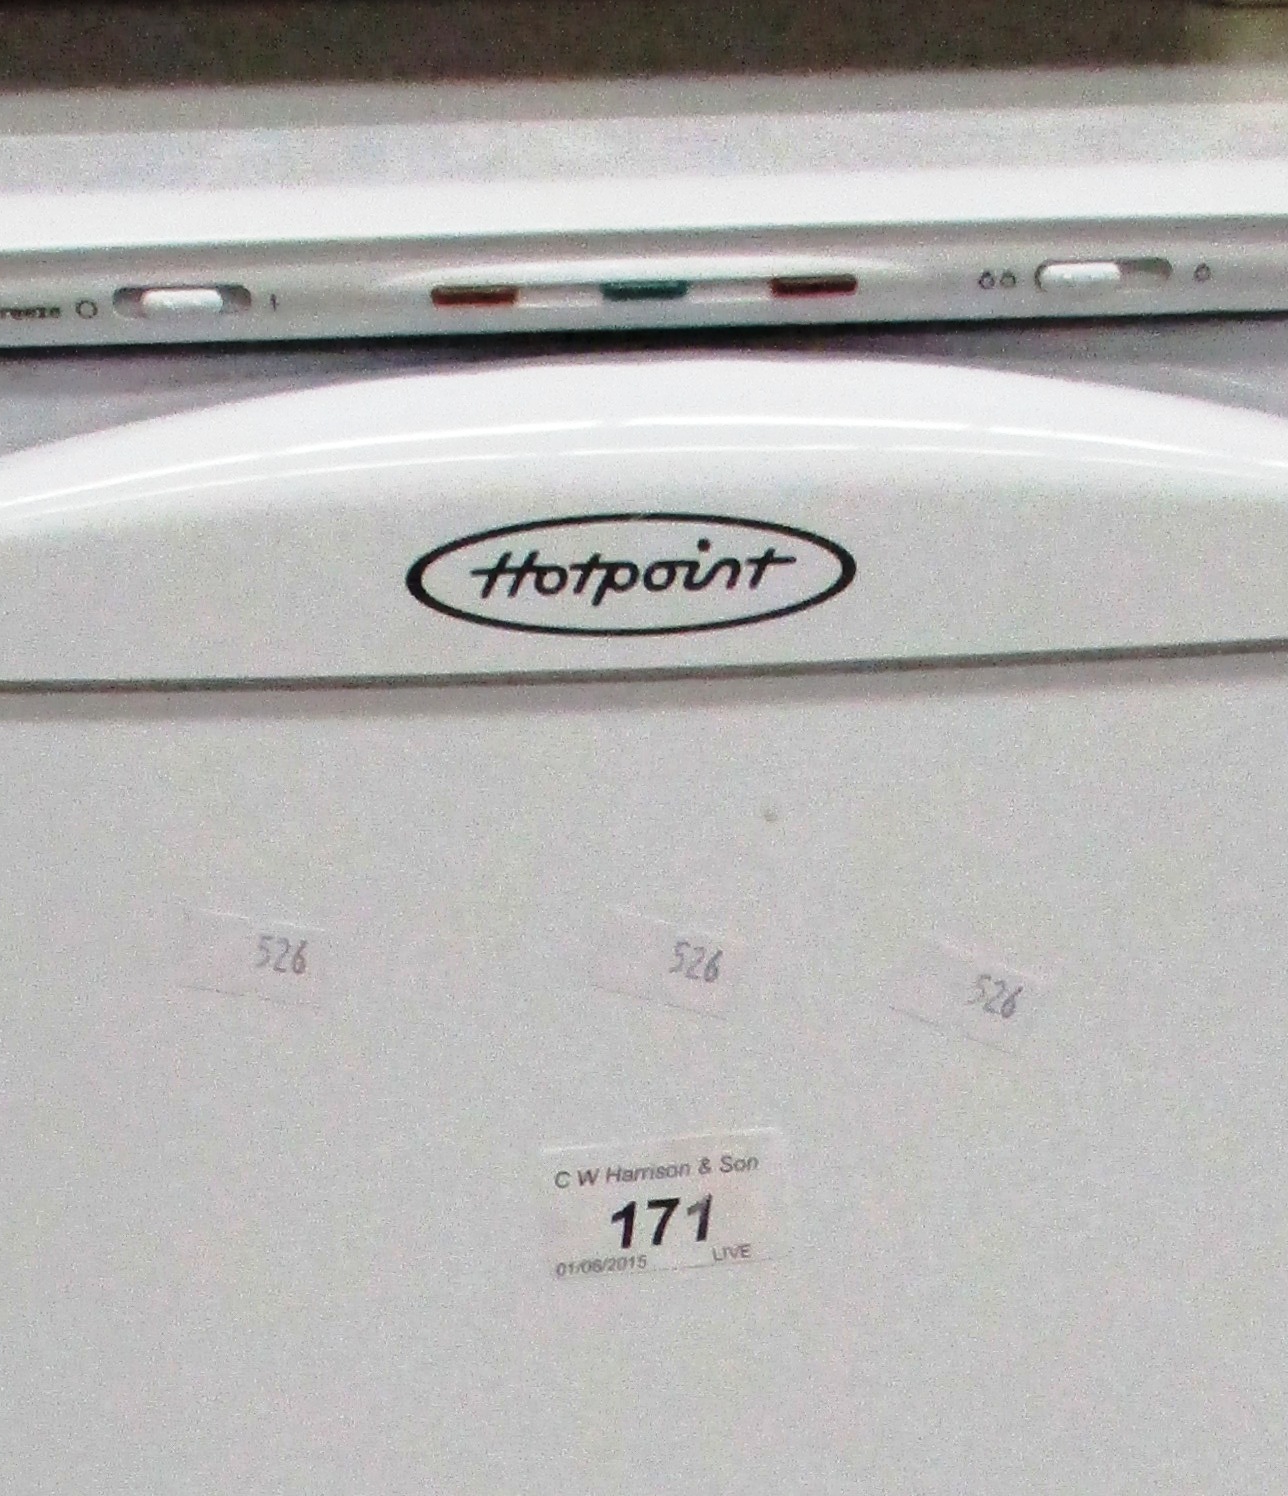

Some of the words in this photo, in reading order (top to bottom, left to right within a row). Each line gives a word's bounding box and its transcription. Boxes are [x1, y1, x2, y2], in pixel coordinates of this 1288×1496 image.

[469, 537, 797, 607] Hotpoint
[256, 933, 309, 975] 526
[669, 939, 724, 983] 526
[964, 973, 1024, 1019] 526
[554, 1170, 571, 1189] C
[577, 1168, 601, 1187] W
[605, 1162, 691, 1184] Harrison
[697, 1157, 714, 1175] &
[719, 1154, 760, 1174] Son
[610, 1193, 713, 1250] 171
[711, 1244, 752, 1262] LIVE
